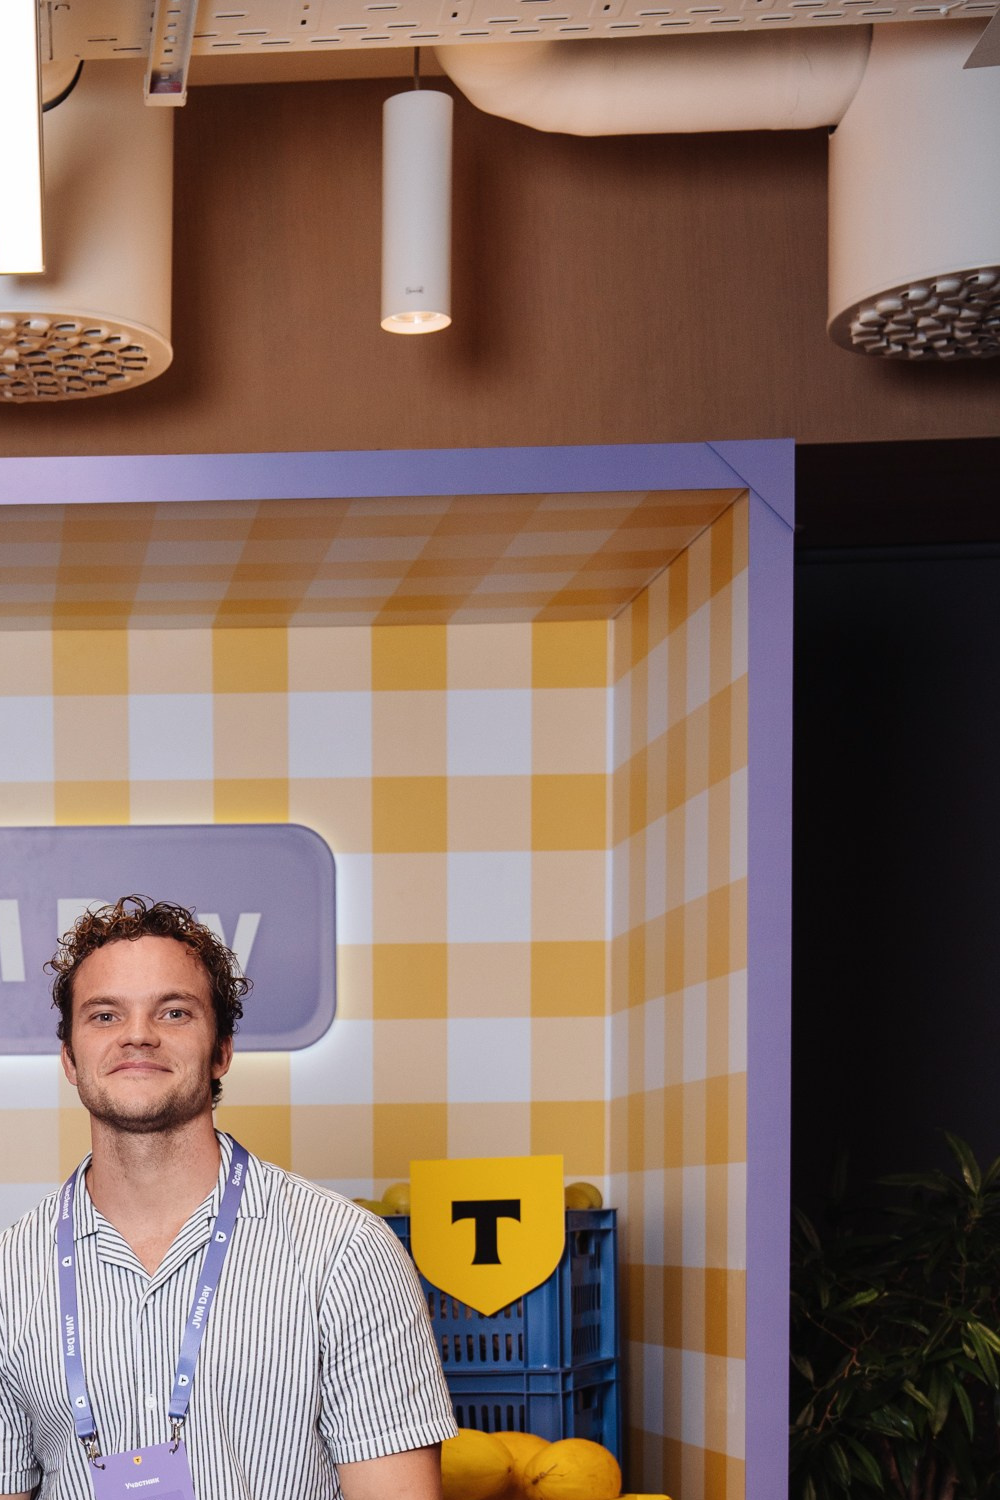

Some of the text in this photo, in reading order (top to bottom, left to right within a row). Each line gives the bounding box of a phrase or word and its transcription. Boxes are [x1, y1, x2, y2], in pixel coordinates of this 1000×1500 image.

[57, 898, 262, 990] Dy
[232, 1163, 244, 1187] Scala
[451, 1198, 521, 1265] T
[192, 1285, 212, 1330] JVM Day
[65, 1314, 75, 1357] JVM Day
[125, 1477, 160, 1490] Участник
